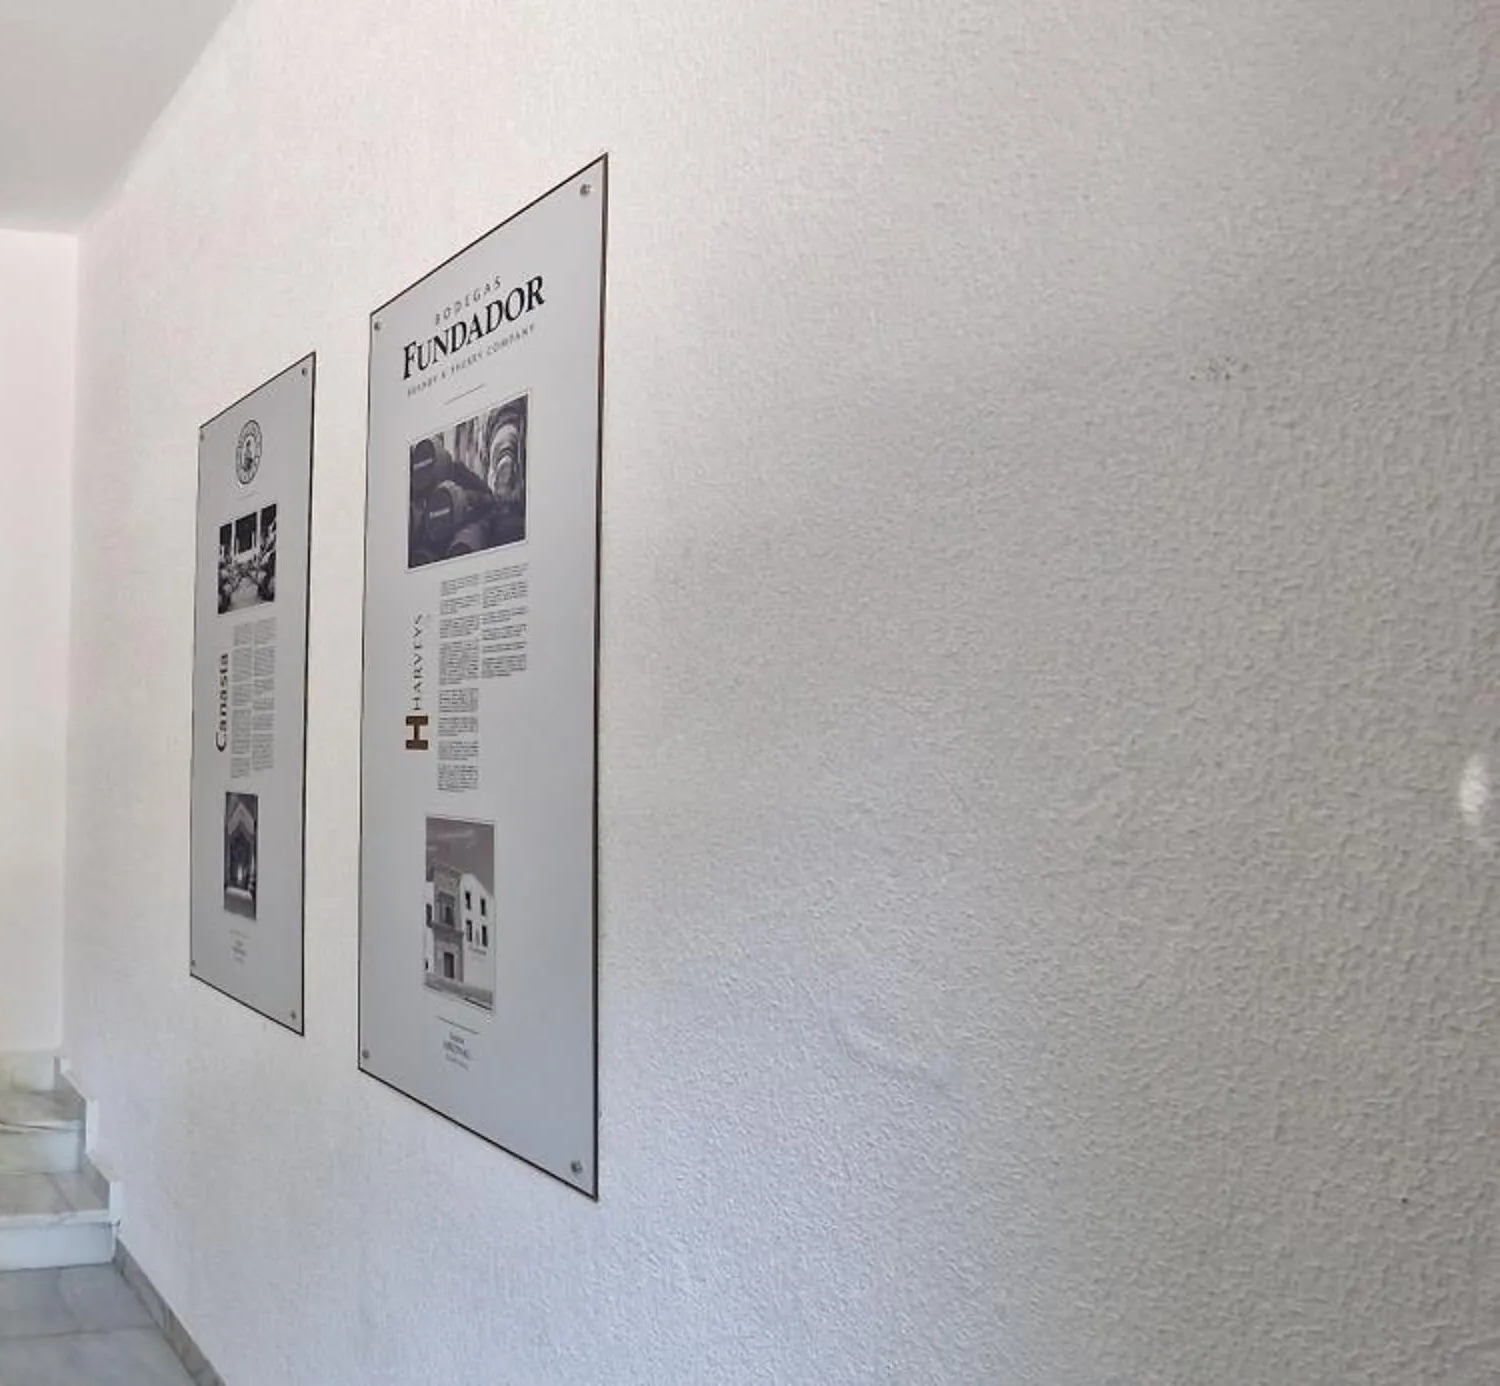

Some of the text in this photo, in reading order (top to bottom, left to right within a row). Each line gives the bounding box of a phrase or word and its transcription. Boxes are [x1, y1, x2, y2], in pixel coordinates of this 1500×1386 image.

[403, 275, 546, 381] FUNDADOR
[435, 276, 501, 325] BODEGAS
[485, 322, 536, 358] COMPANY
[215, 653, 229, 752] Canasta
[412, 612, 424, 711] HARVEYS
